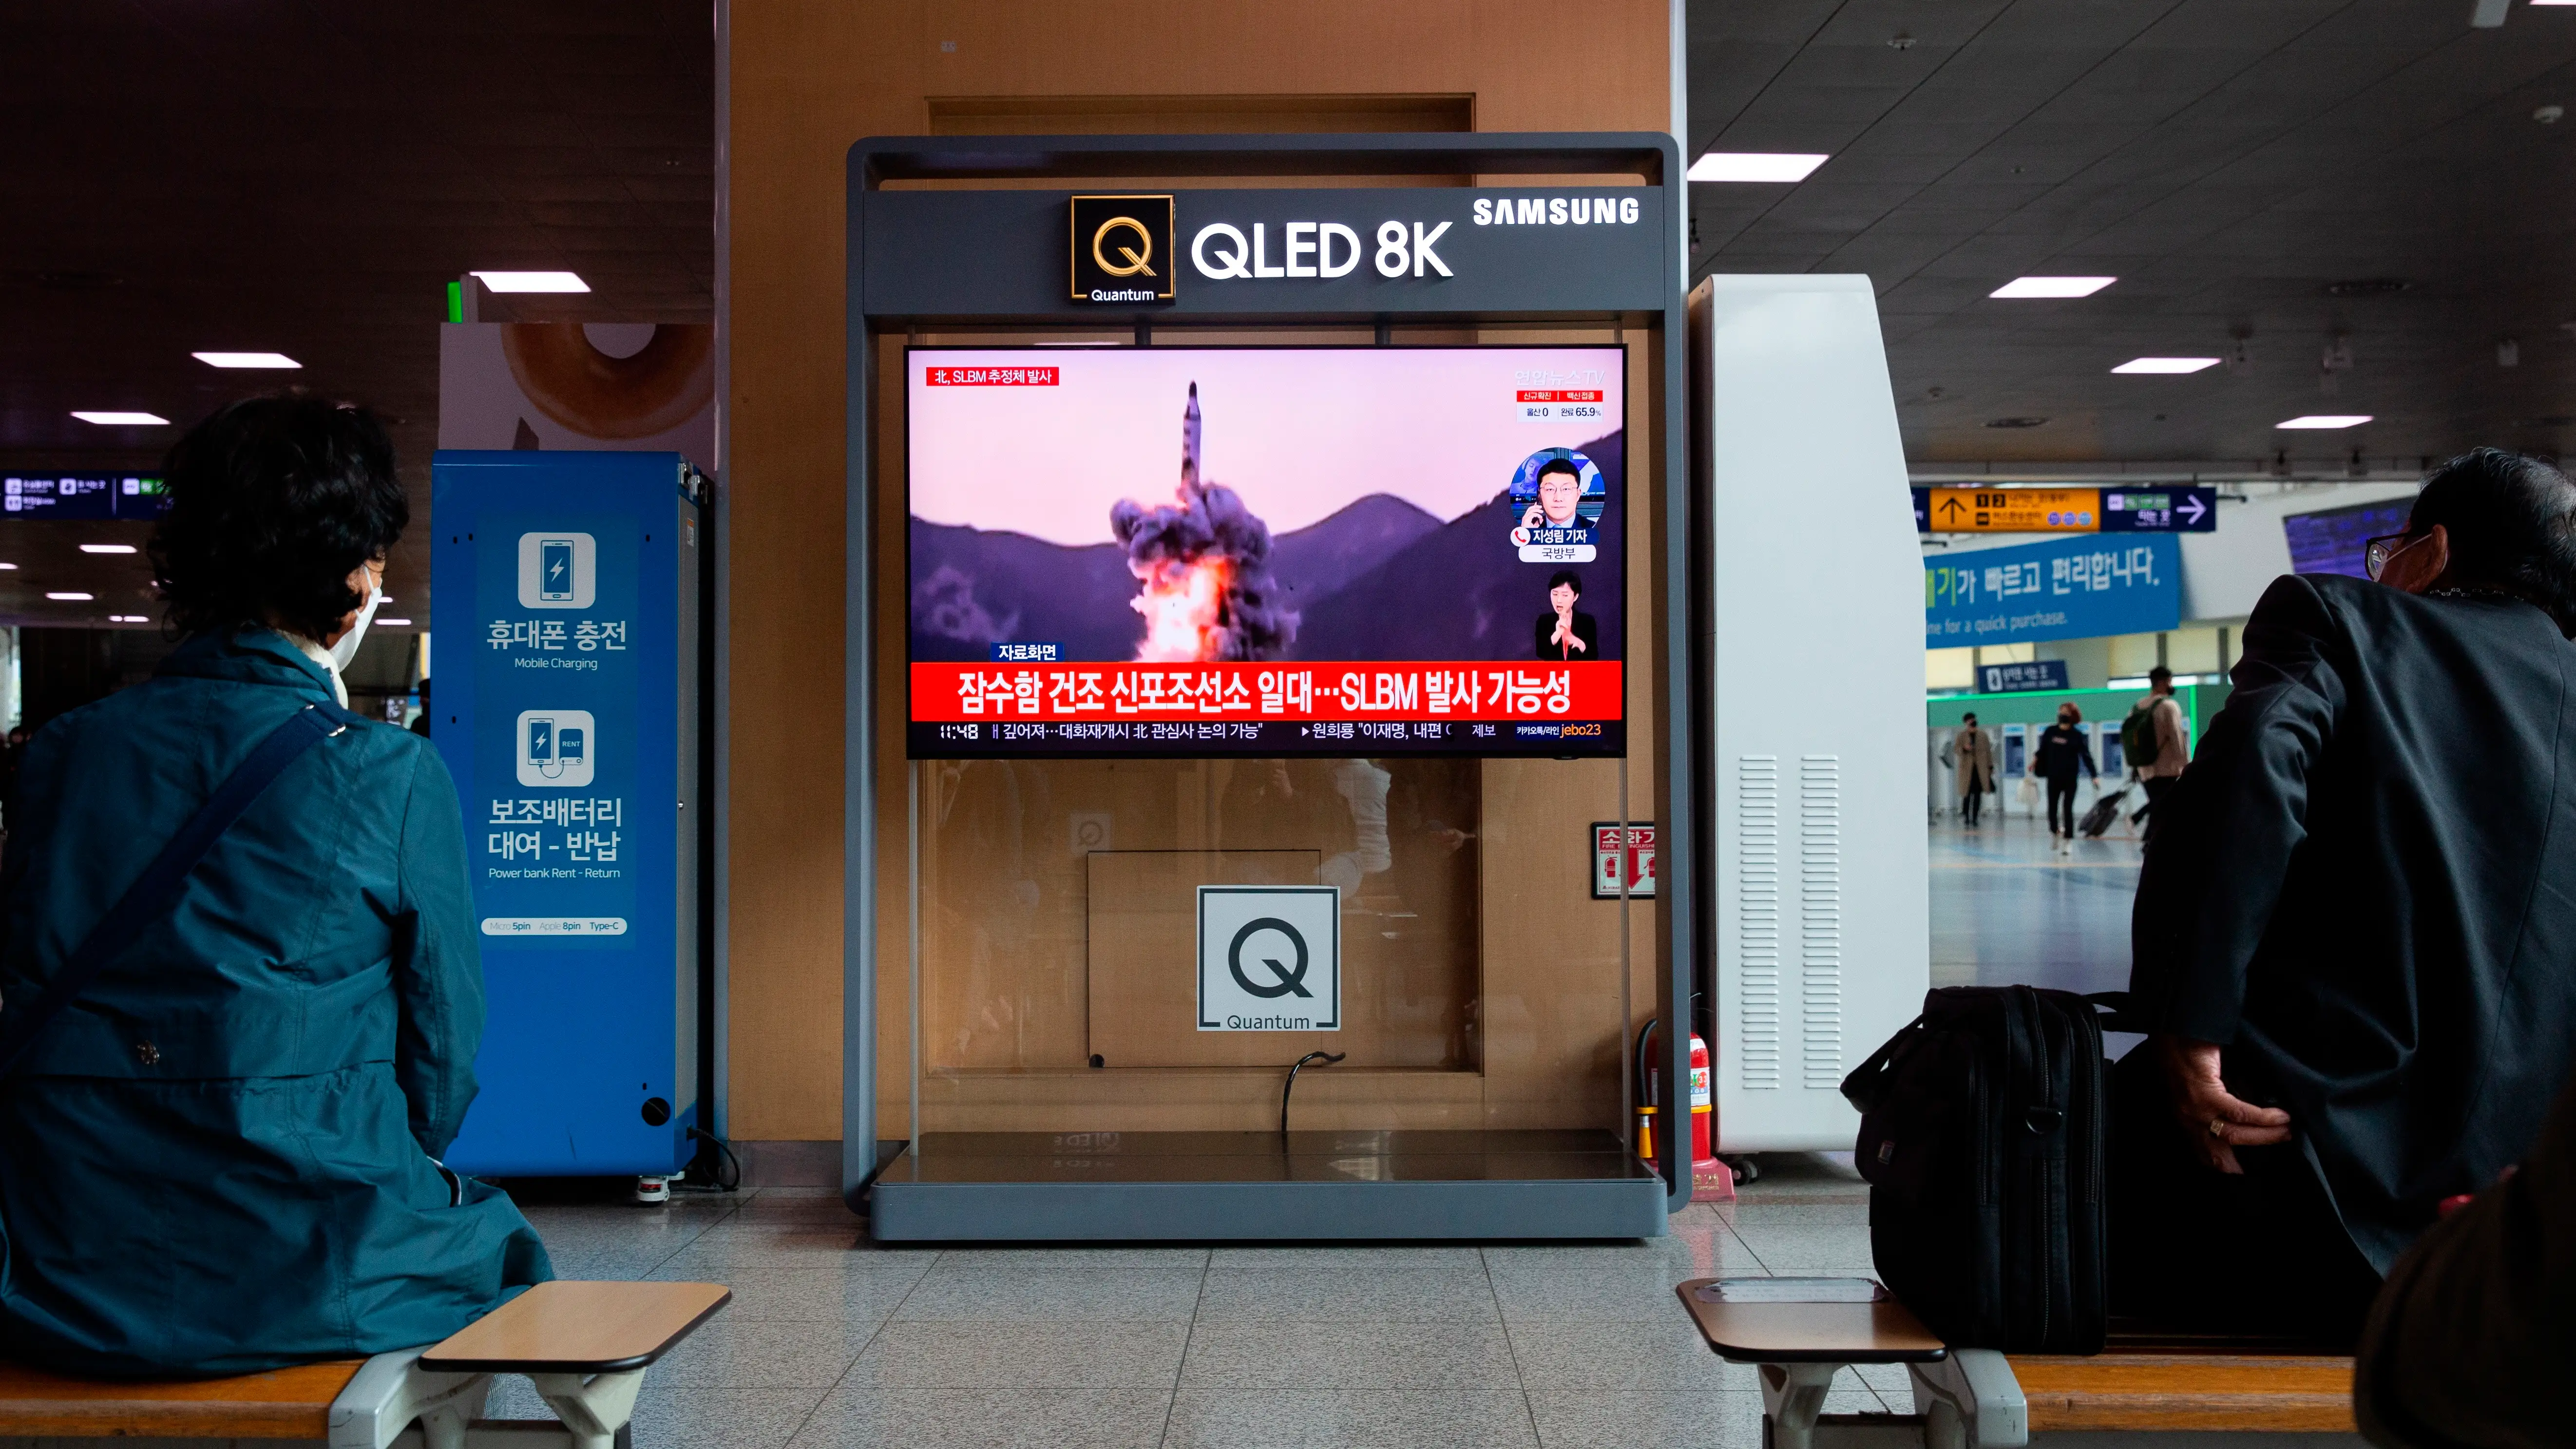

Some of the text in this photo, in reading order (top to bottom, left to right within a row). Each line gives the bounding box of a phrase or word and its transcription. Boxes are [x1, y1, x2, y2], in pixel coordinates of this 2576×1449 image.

[1473, 197, 1640, 226] SAMSUNG
[1093, 217, 1157, 277] Q
[1191, 221, 1454, 279] QLED 8K
[1091, 289, 1154, 301] Quantum
[953, 370, 986, 383] SLBM
[988, 369, 1025, 384] 추정체
[1027, 369, 1052, 384] 발사
[1542, 407, 1548, 417] 0
[1561, 408, 1574, 417] 완료
[1533, 529, 1587, 543] 지성림 기자
[1542, 548, 1575, 559] 국방부
[1984, 561, 2041, 602] 빠르고
[2052, 546, 2160, 595] 편리합니다.
[1974, 614, 2006, 635] quick
[487, 620, 626, 651] 휴대폰 충전
[998, 644, 1056, 661] 자료화면
[515, 658, 598, 670] Mobile Charging
[957, 671, 1043, 714] 잠수함
[1049, 671, 1105, 714] 건조
[1111, 670, 1252, 714] 신포조선소
[1425, 670, 1482, 713] 발사
[1488, 670, 1571, 714] 가능성
[941, 724, 978, 740] 11:48
[1133, 724, 1148, 739] 北
[1151, 724, 1195, 739] 관심사
[1198, 724, 1226, 739] 논의
[1312, 723, 1355, 739] 원희룡
[1414, 723, 1442, 739] 내편
[1472, 724, 1496, 738] 제보
[1517, 724, 1602, 738] 카카오톡/라인 jebo23
[489, 798, 621, 827] 보조배터리
[489, 831, 540, 860] 대여
[567, 831, 621, 861] 반납
[489, 868, 522, 878] Power
[524, 868, 550, 878] bank
[552, 868, 576, 878] Rent
[585, 868, 620, 878] Return
[513, 922, 531, 931] 5pin
[563, 922, 581, 931] 8pin
[590, 922, 619, 931] Type-C
[1228, 917, 1314, 998] Q
[1227, 1015, 1309, 1029] Quantum
